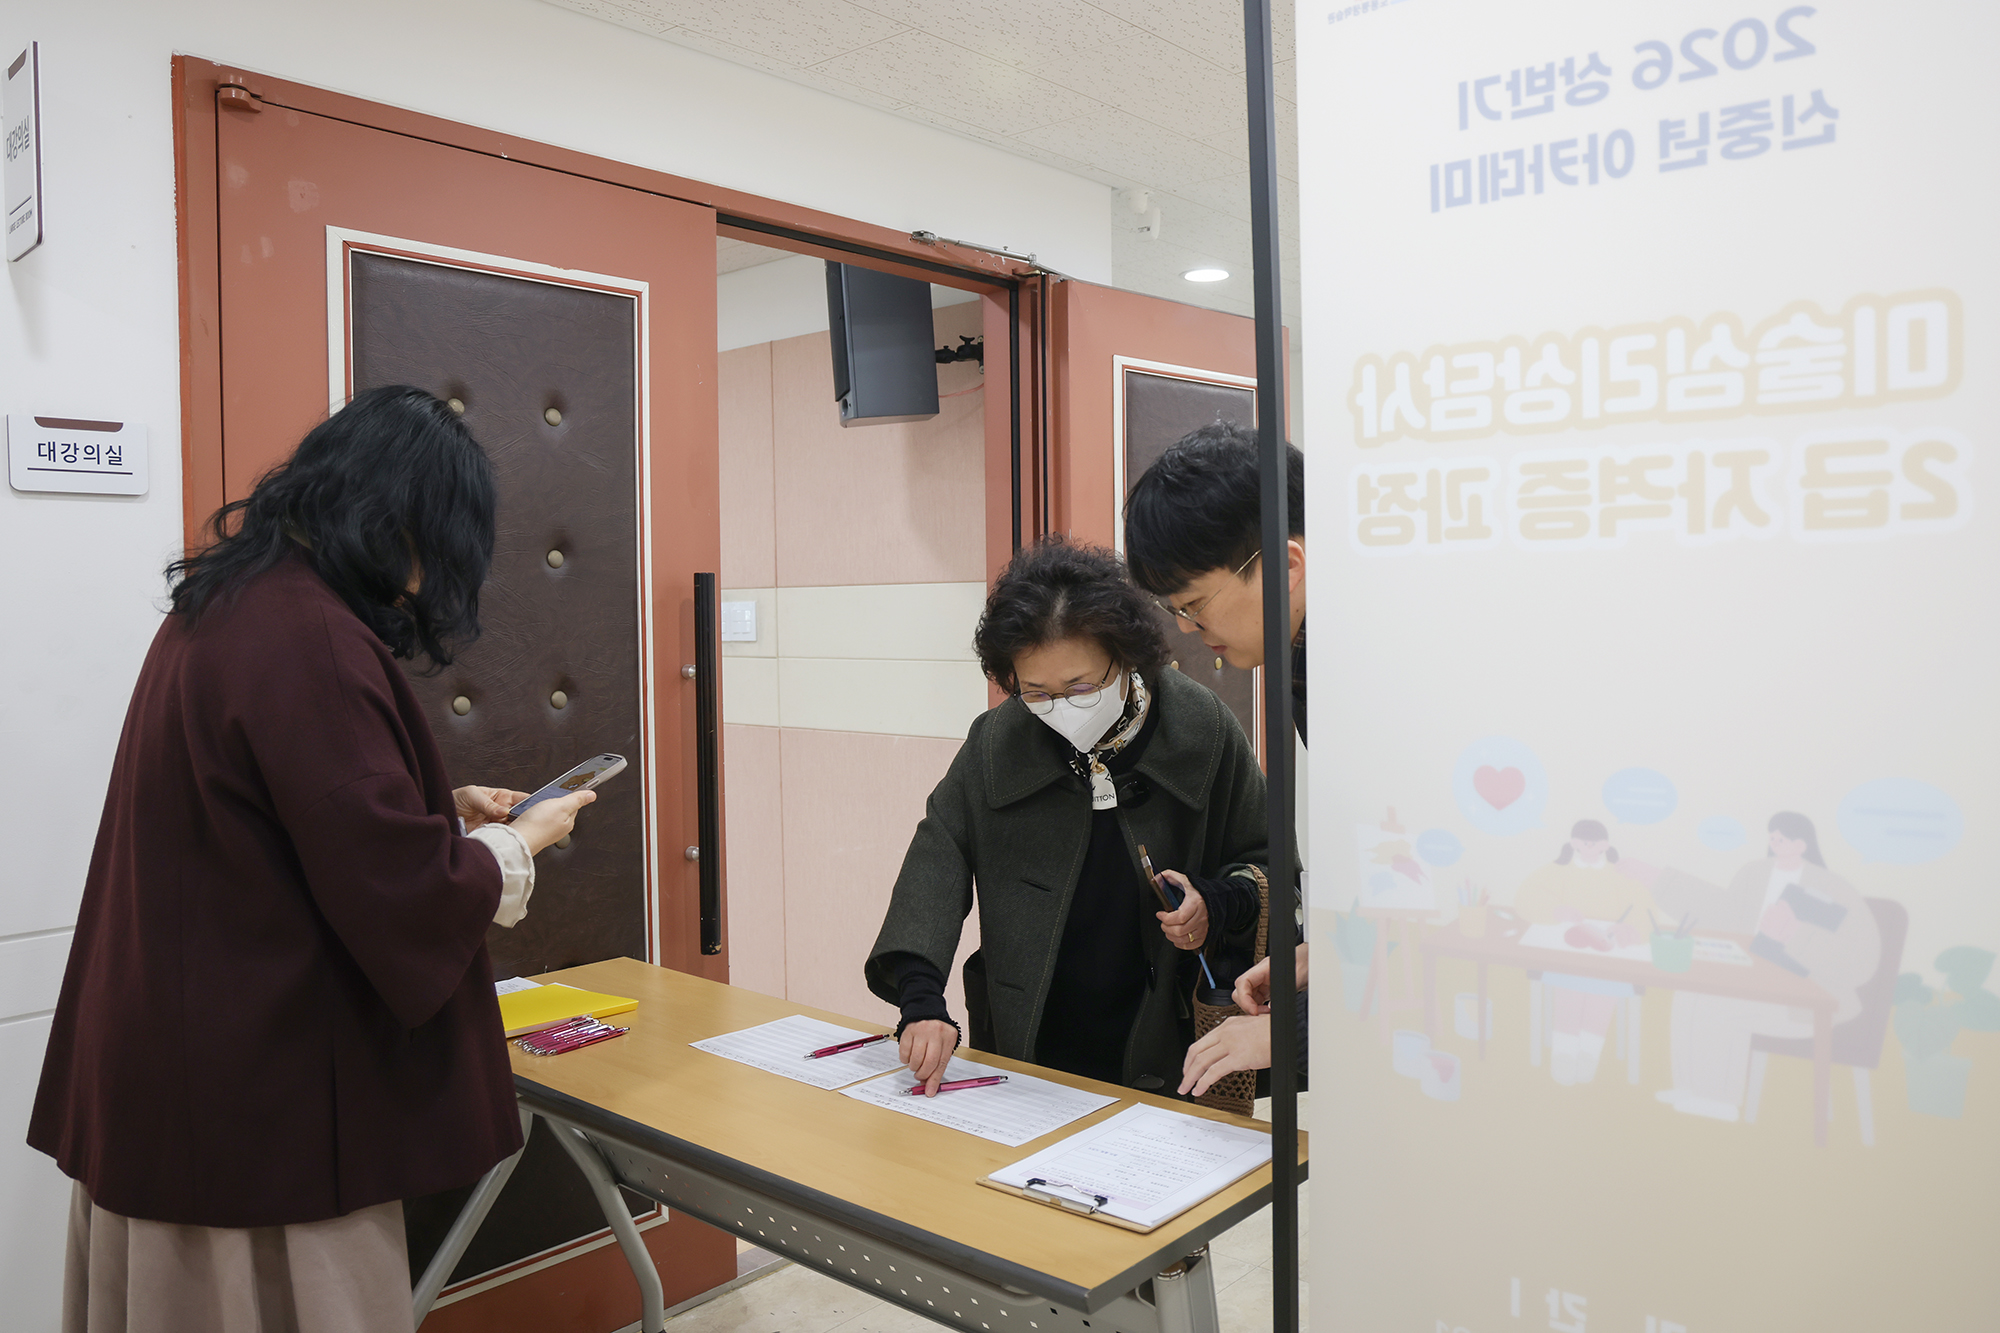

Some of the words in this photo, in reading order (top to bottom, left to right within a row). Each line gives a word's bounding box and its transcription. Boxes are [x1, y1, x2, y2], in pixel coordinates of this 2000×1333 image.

[6, 114, 30, 163] 대강의실
[37, 441, 123, 466] 대강의실
[1092, 793, 1115, 803] ITTON
